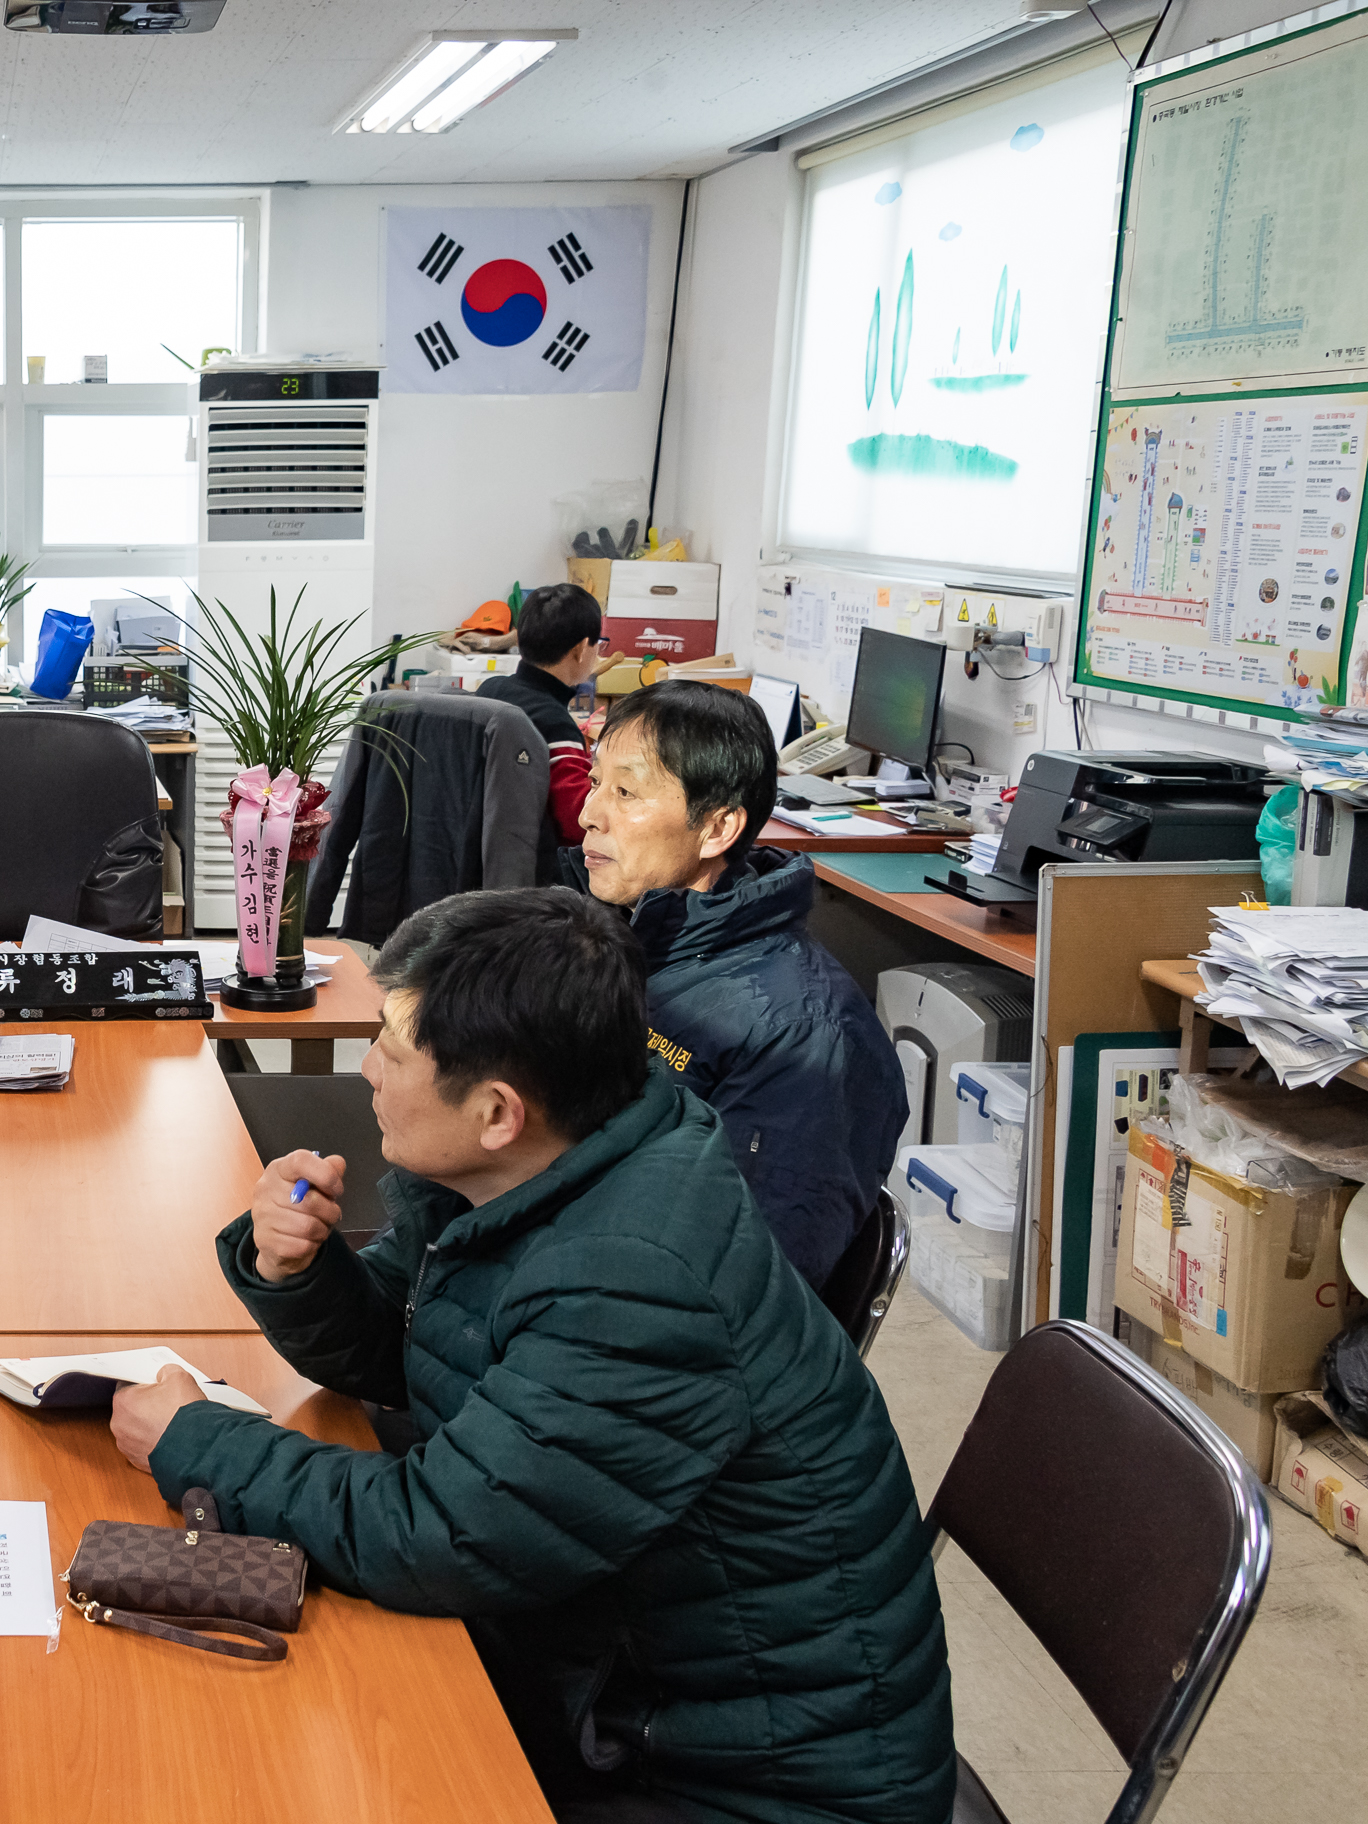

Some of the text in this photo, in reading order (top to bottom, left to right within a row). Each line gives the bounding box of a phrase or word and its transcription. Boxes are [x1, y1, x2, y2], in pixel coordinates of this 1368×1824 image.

[281, 378, 299, 395] 23
[267, 519, 306, 529] Carrier
[240, 839, 258, 886] 가수
[1322, 1442, 1345, 1459] 수량
